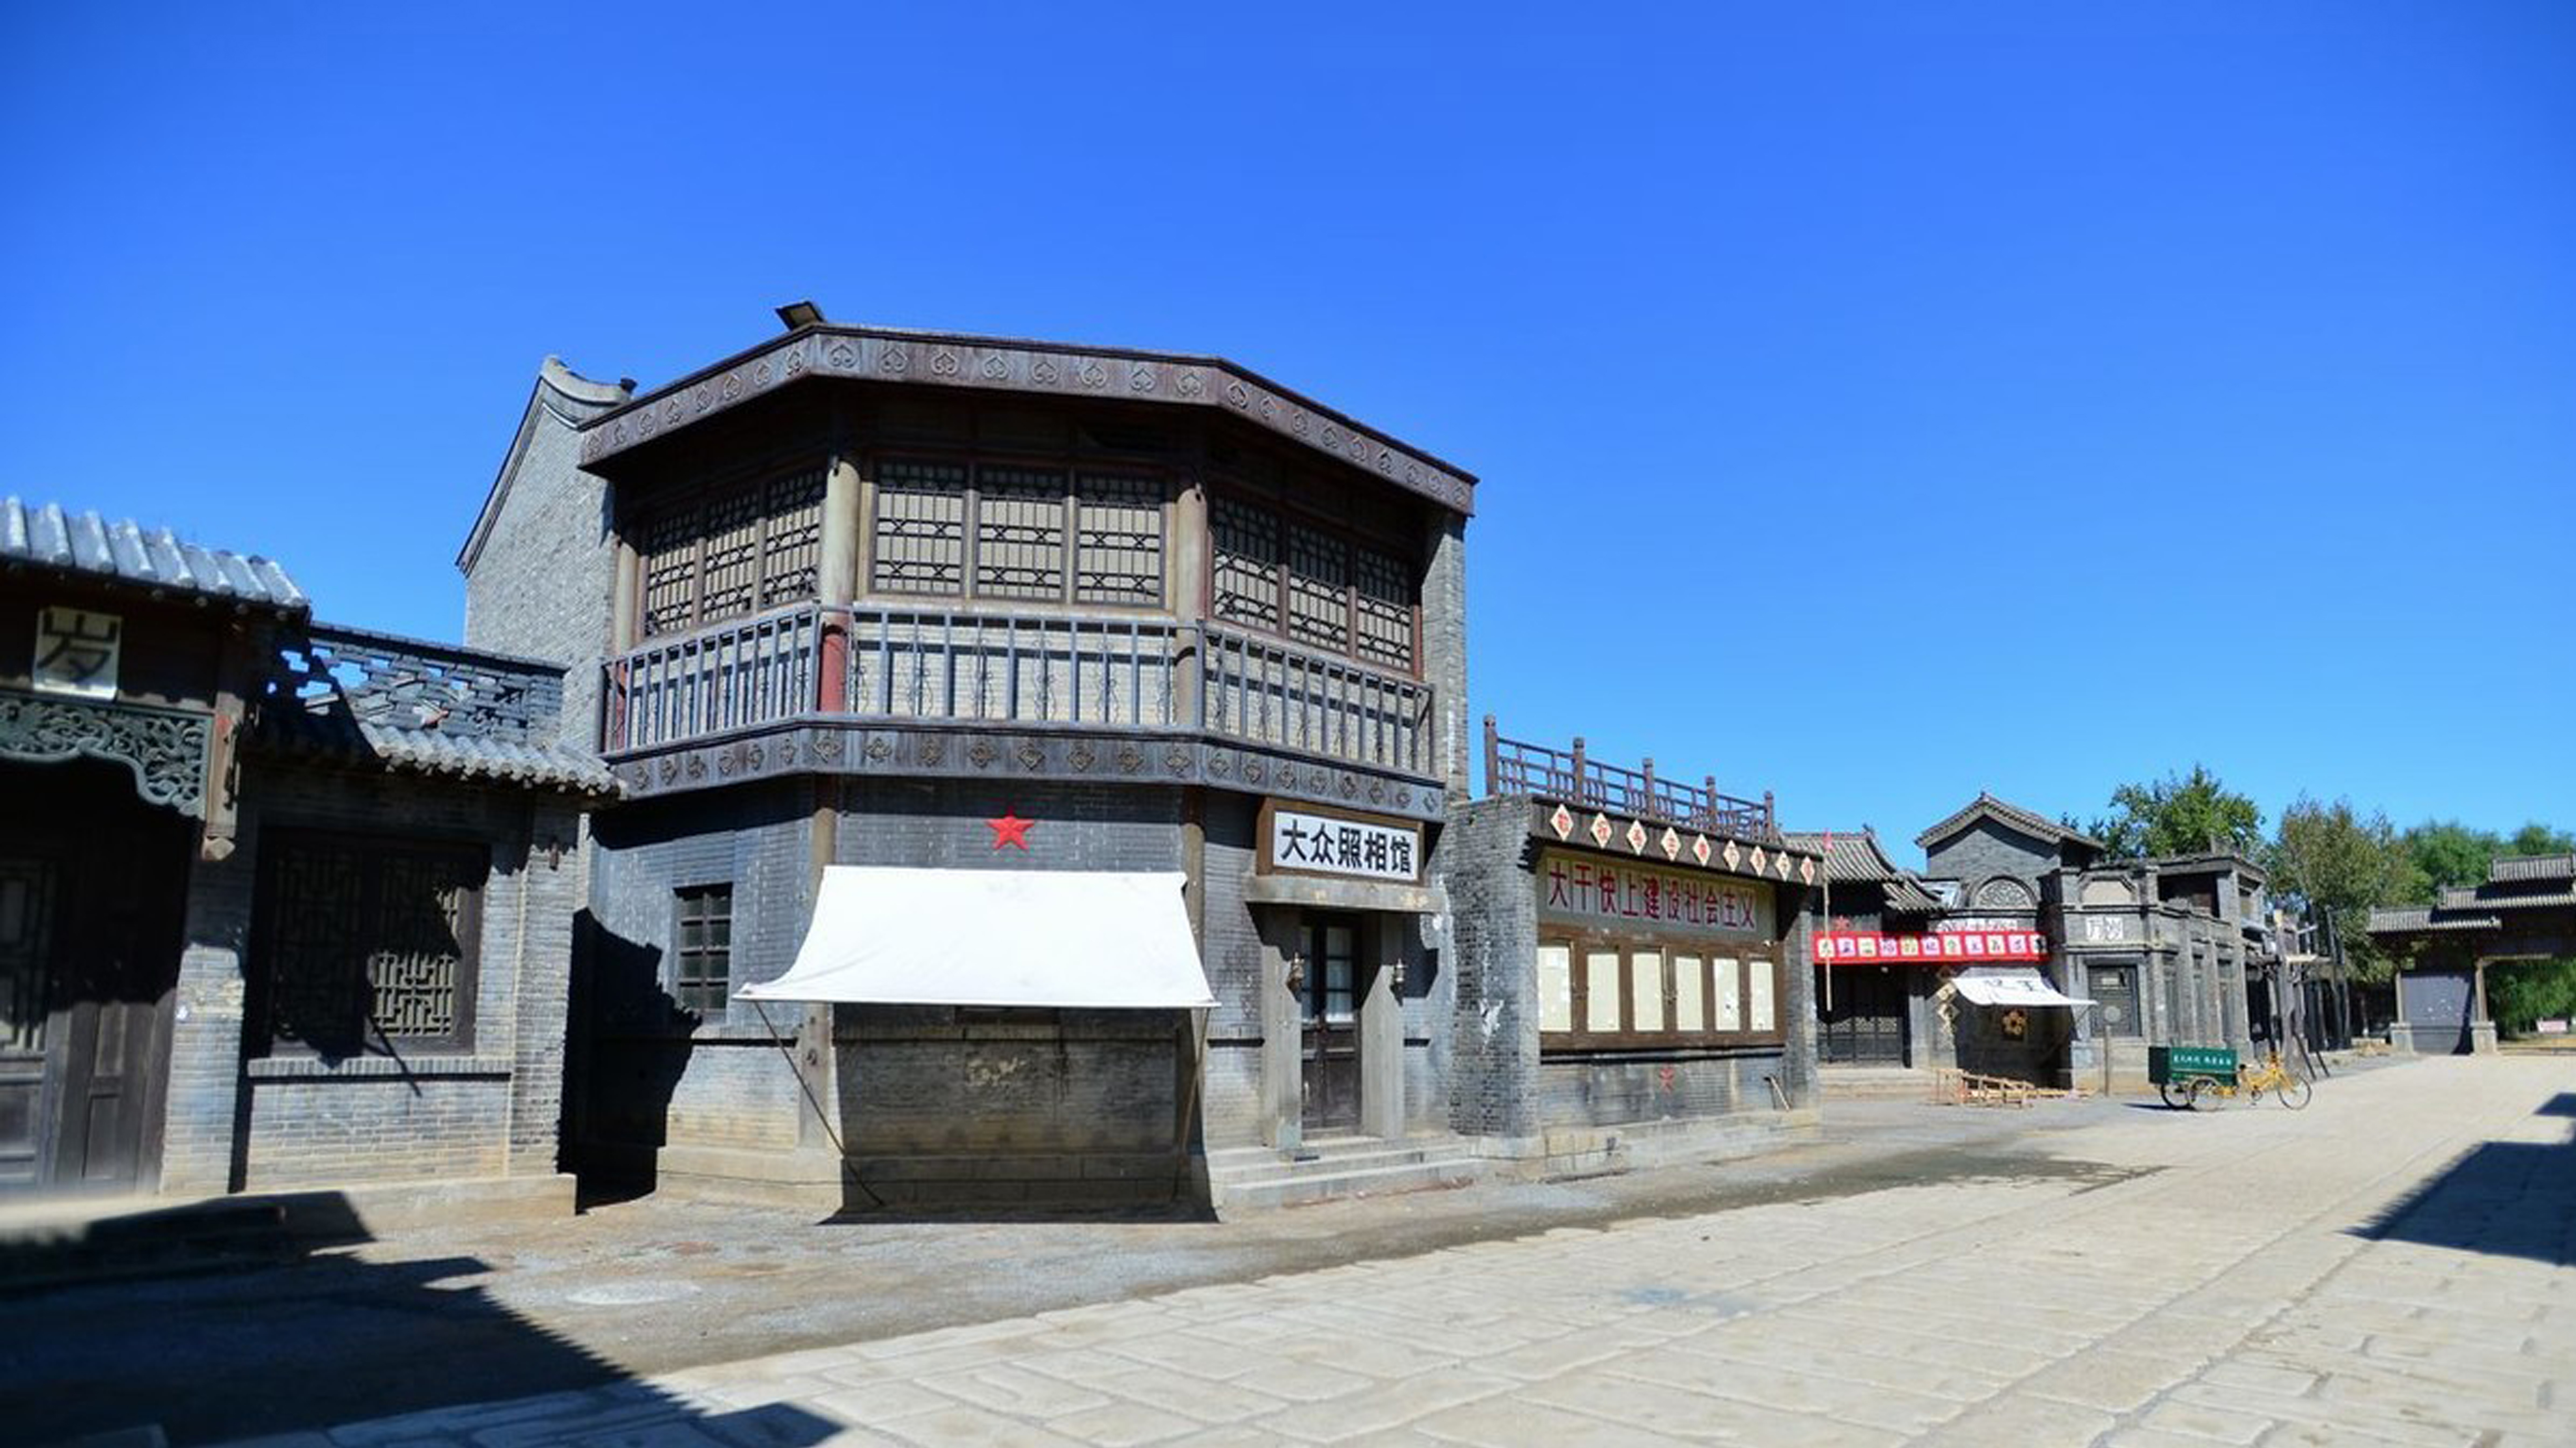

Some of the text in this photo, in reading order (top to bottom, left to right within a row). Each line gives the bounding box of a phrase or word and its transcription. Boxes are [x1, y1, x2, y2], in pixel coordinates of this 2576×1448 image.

[1281, 819, 1412, 873] 大众照相馆
[1548, 861, 1755, 929] 大干快上建设社会主义
